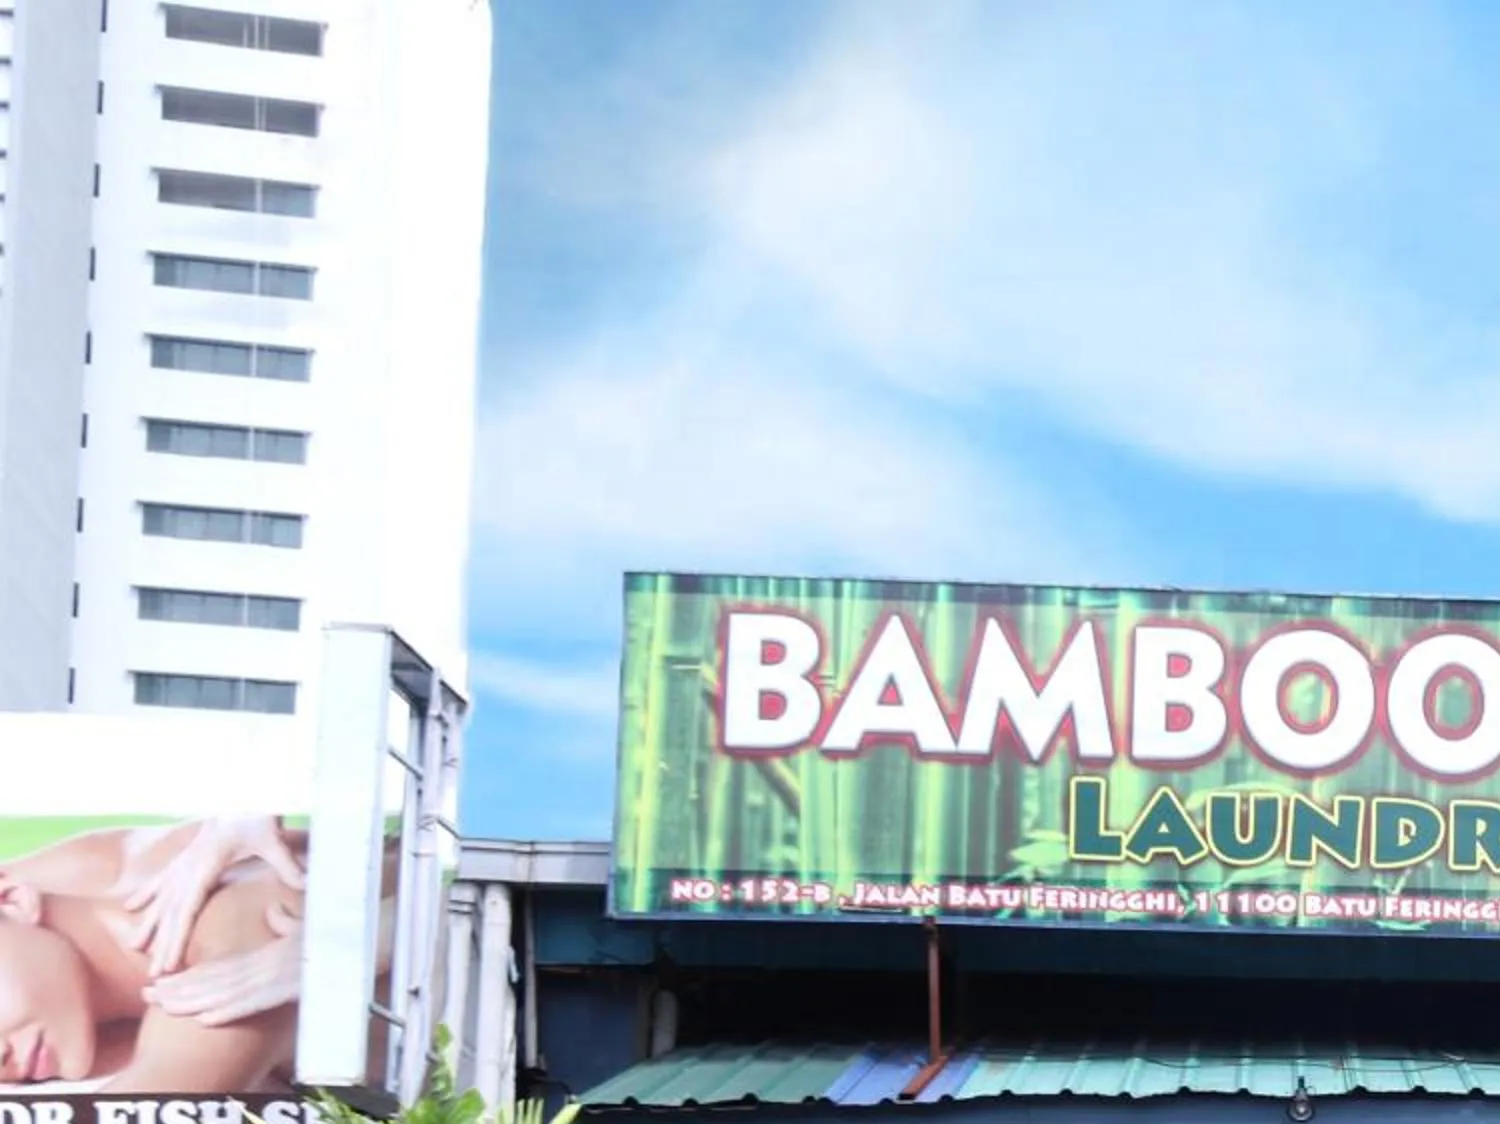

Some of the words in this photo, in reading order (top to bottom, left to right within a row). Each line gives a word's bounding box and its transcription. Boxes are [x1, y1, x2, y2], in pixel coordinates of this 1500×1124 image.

[853, 883, 940, 906] JALAN
[949, 885, 1021, 908] BATU
[1030, 887, 1185, 912] FERINGGHI,
[1195, 892, 1297, 915] 11100
[1305, 895, 1376, 918] BATU
